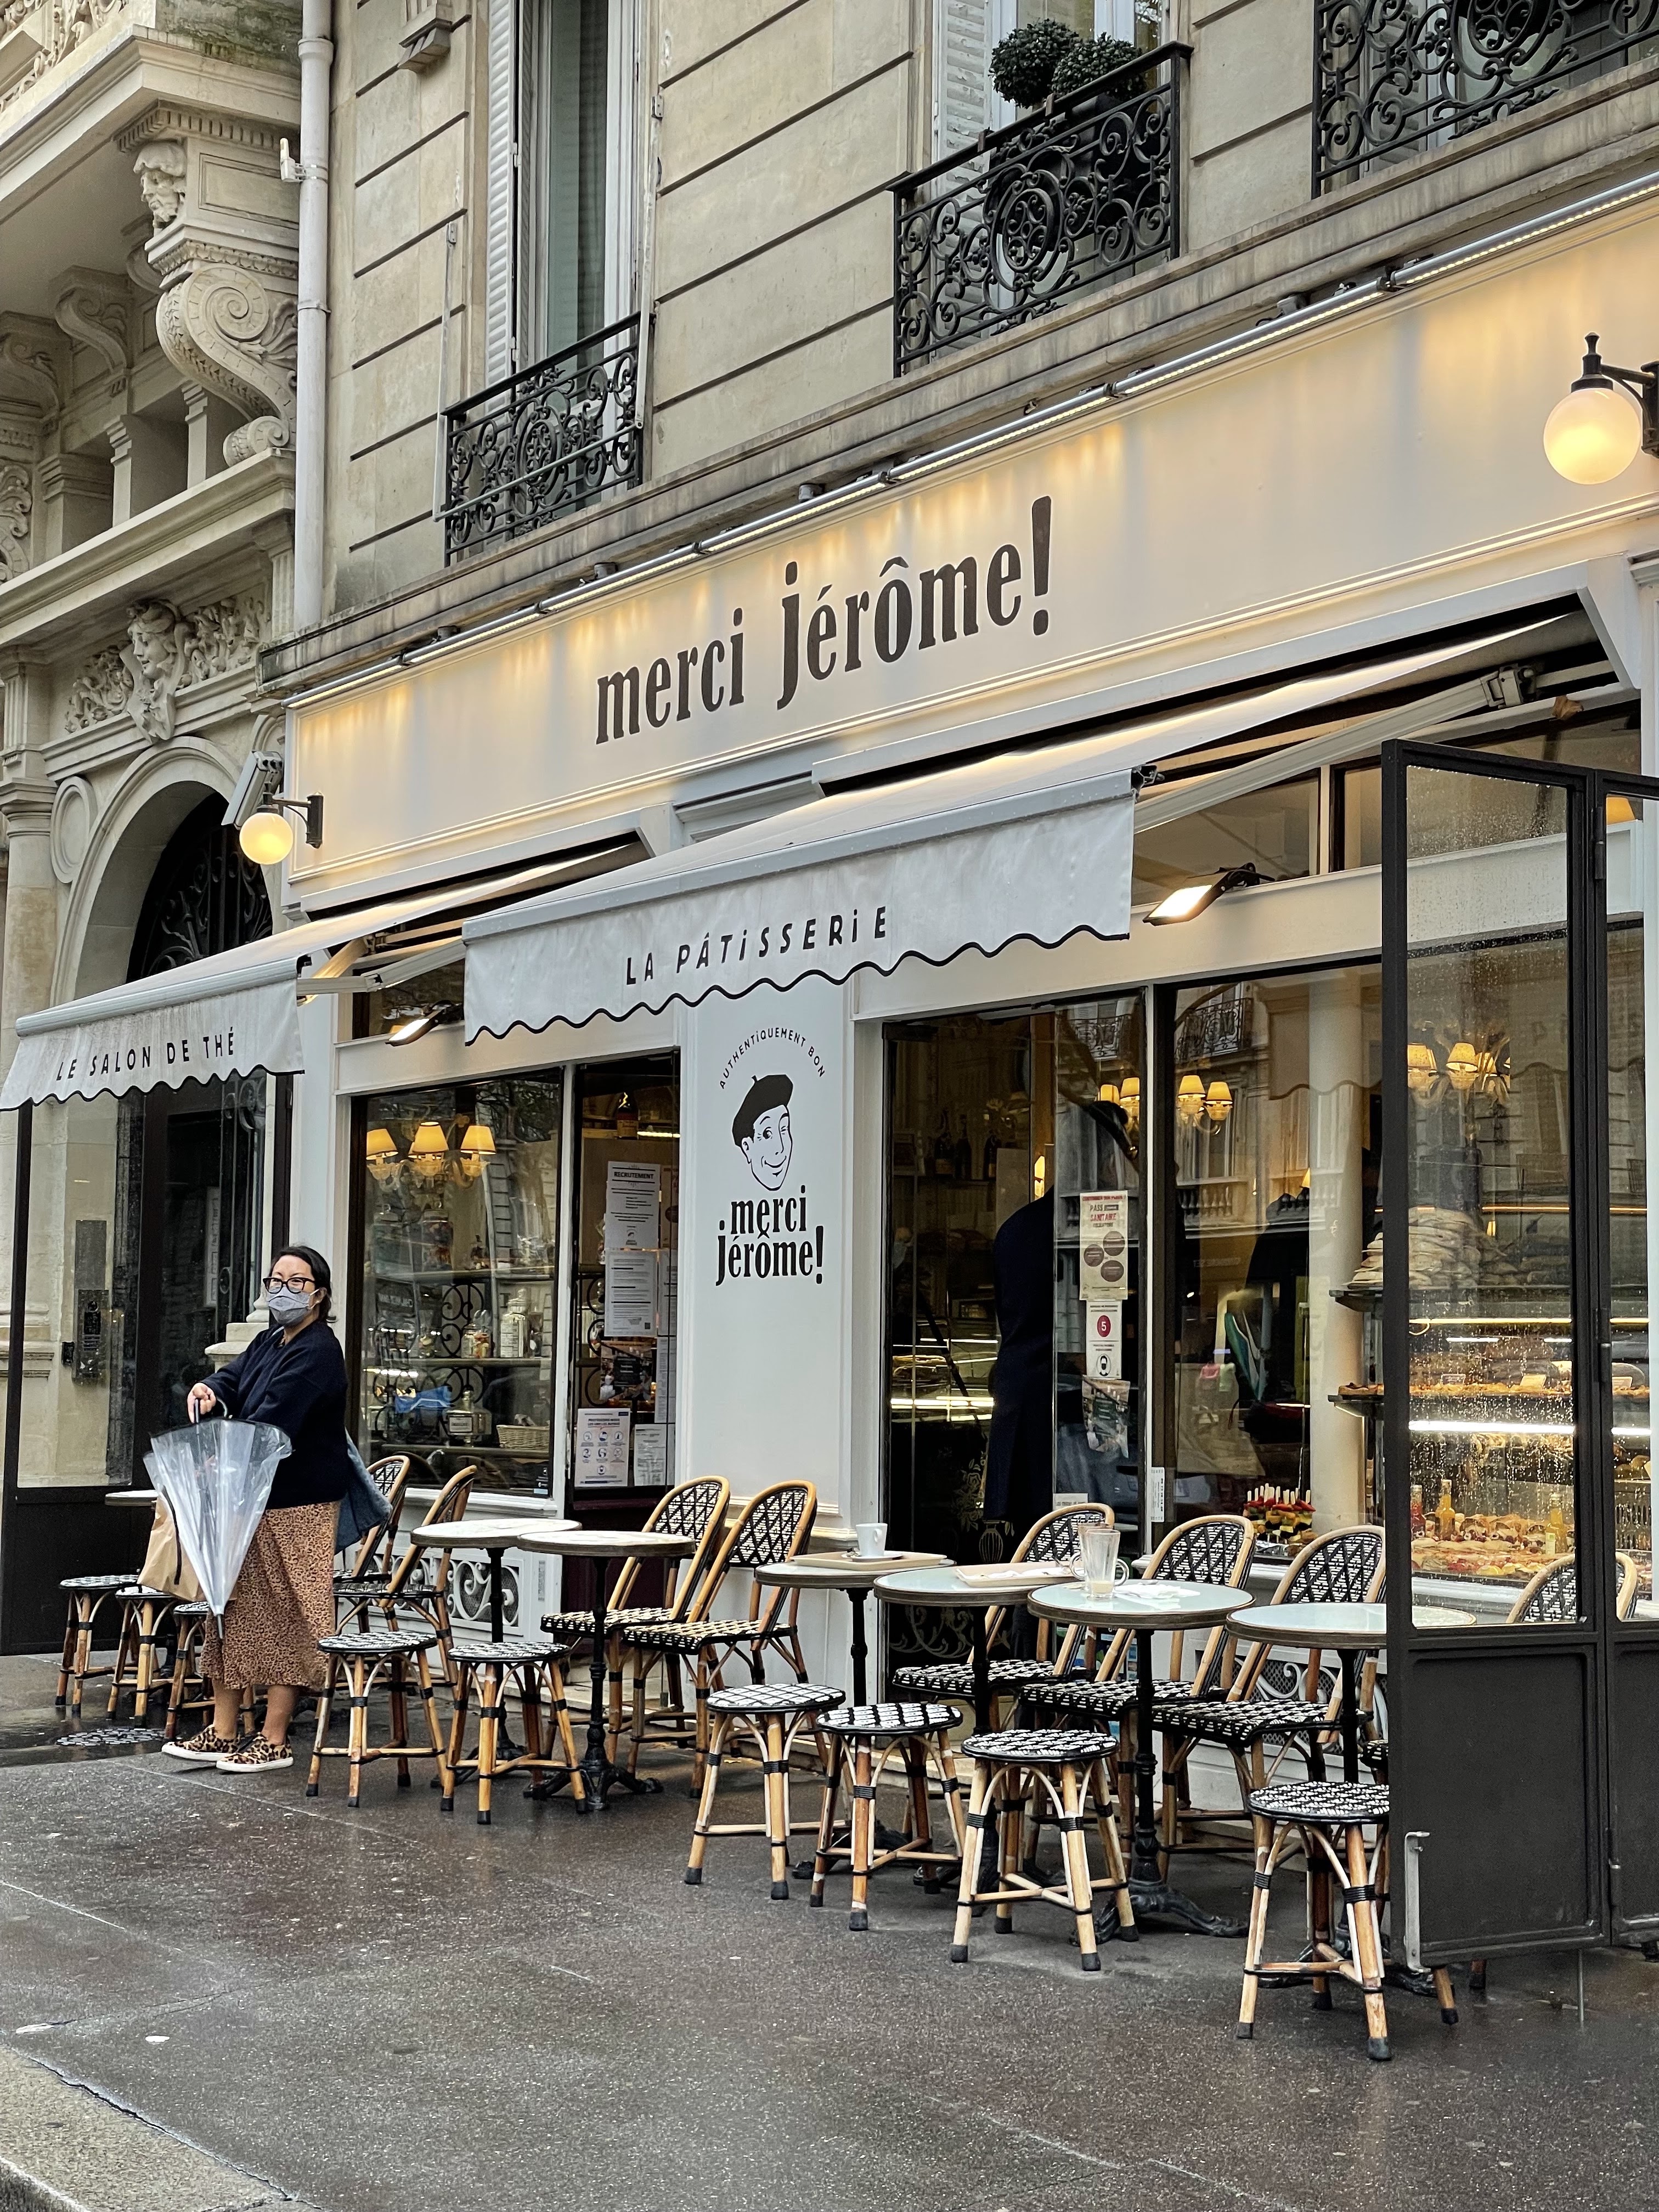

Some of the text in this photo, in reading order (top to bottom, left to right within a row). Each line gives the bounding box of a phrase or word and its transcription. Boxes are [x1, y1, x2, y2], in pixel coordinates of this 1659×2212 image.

[596, 495, 1052, 745] merci jérôme!
[626, 952, 654, 985] LA
[56, 1026, 234, 1081] LE SALON DE THÉ
[808, 1046, 825, 1077] BON
[614, 1171, 654, 1180] RECRUTEMENT
[730, 1184, 806, 1235] merci
[715, 1220, 824, 1286] jérôme!
[1101, 1321, 1107, 1331] 5
